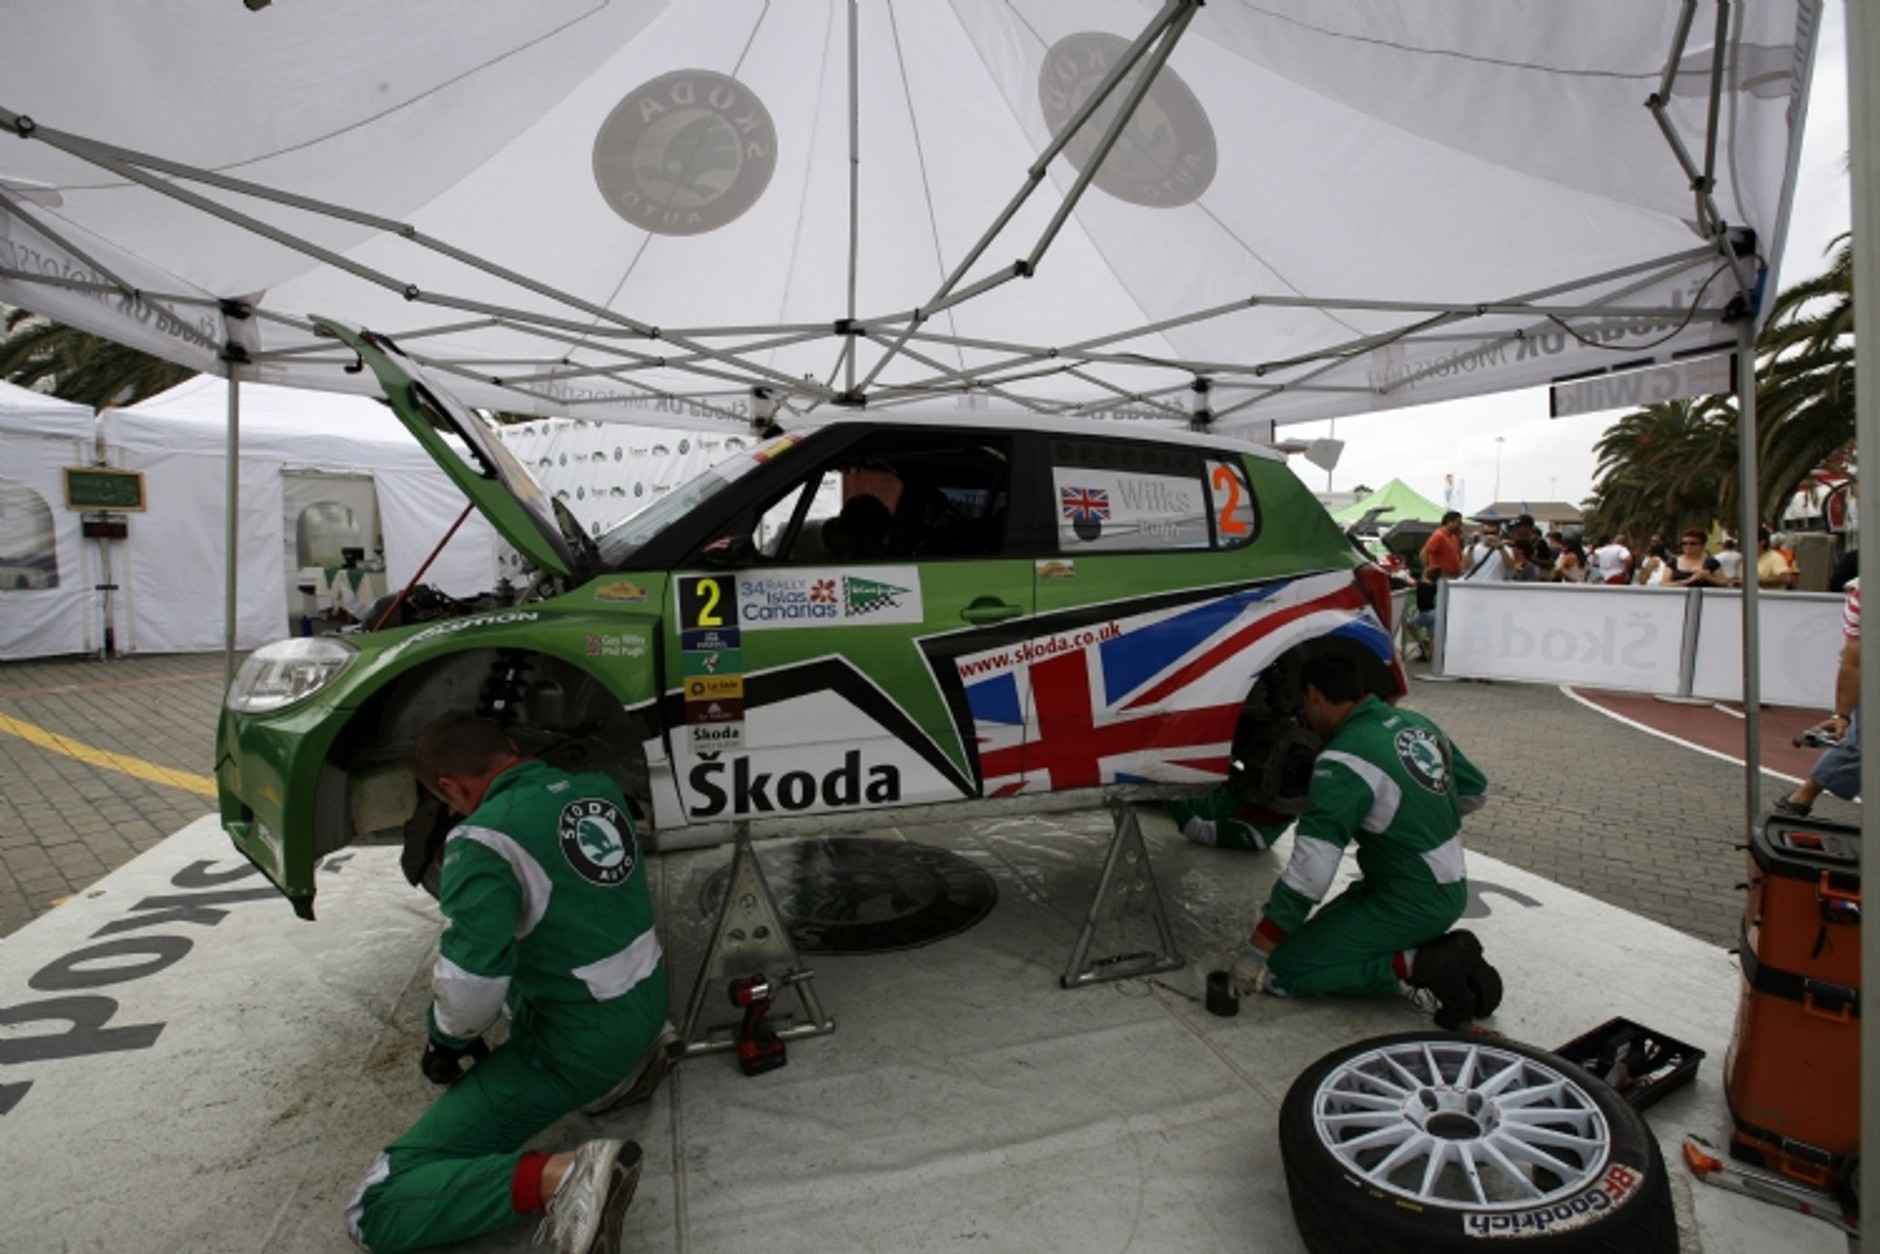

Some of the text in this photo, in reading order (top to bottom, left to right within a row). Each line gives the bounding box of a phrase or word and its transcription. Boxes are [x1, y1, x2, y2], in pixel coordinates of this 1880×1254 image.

[1212, 464, 1247, 533] 2
[696, 576, 724, 626] 2
[741, 579, 806, 597] 34 RALLY
[742, 601, 838, 621] Canarias
[766, 591, 807, 605] Islas
[959, 620, 1122, 678] www.skoda.co.uk
[688, 749, 901, 817] Škoda
